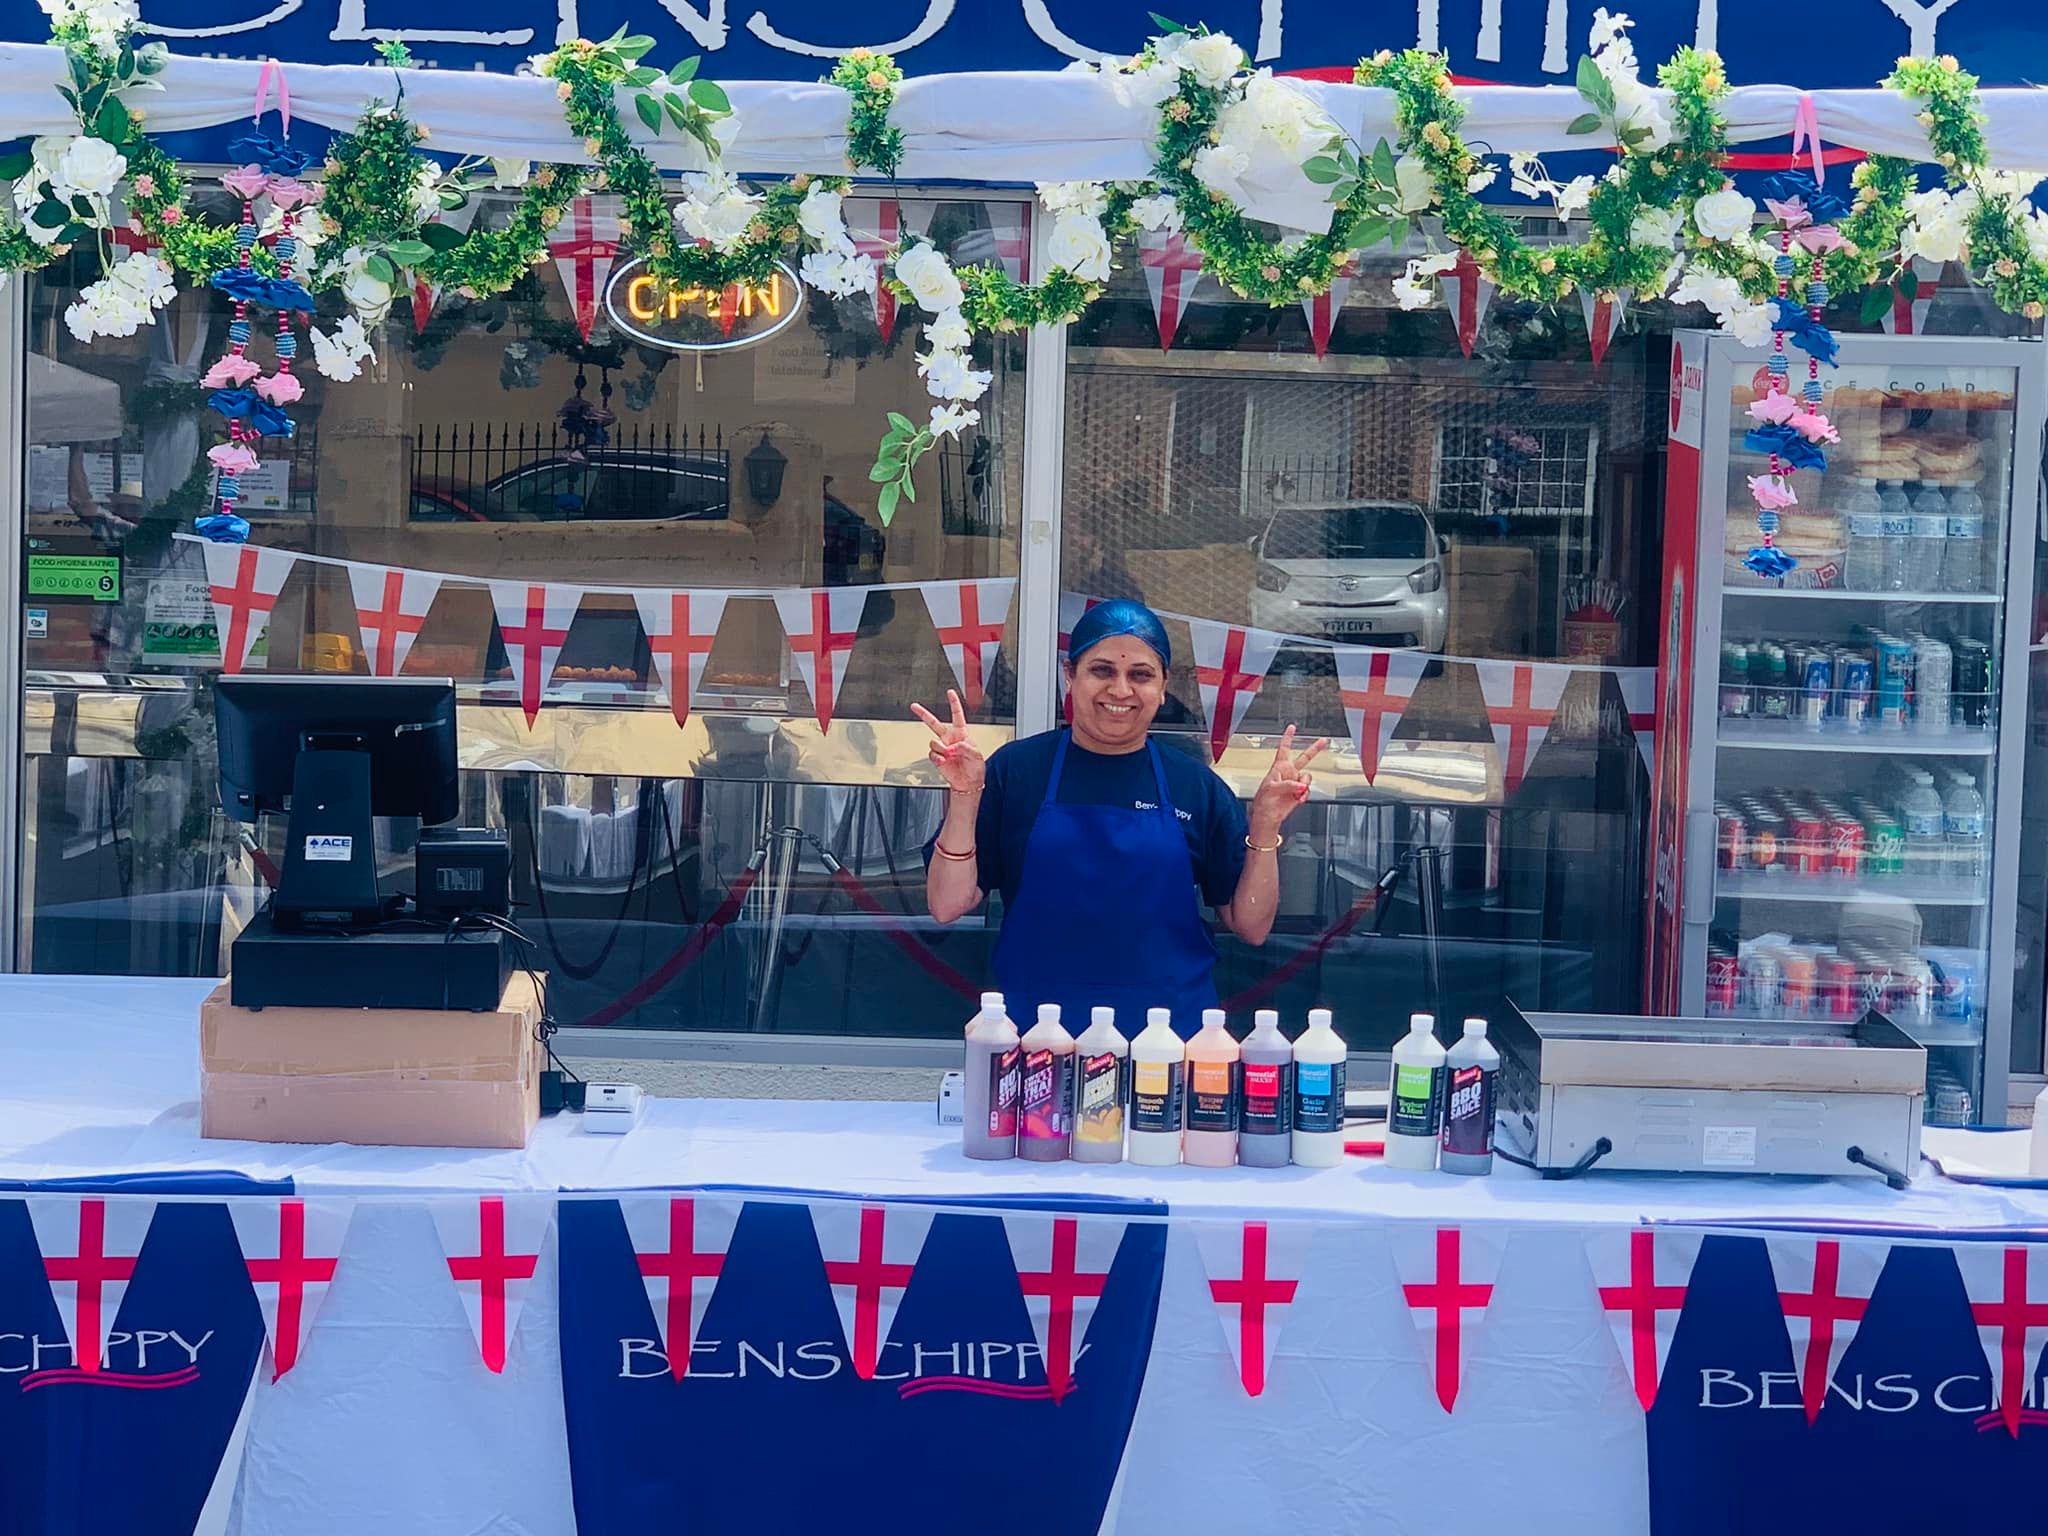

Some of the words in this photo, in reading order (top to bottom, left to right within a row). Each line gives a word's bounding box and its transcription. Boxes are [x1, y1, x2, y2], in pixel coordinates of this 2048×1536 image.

[32, 558, 55, 566] FOOD
[56, 558, 87, 567] HYGIENE
[102, 578, 111, 590] 5
[320, 838, 351, 847] ACE
[1450, 1096, 1482, 1120] SAUCE
[1451, 1082, 1482, 1109] BBQ
[0, 1330, 214, 1372] CHPPY
[619, 1338, 841, 1380] BENS
[1699, 1368, 1919, 1412] BENS
